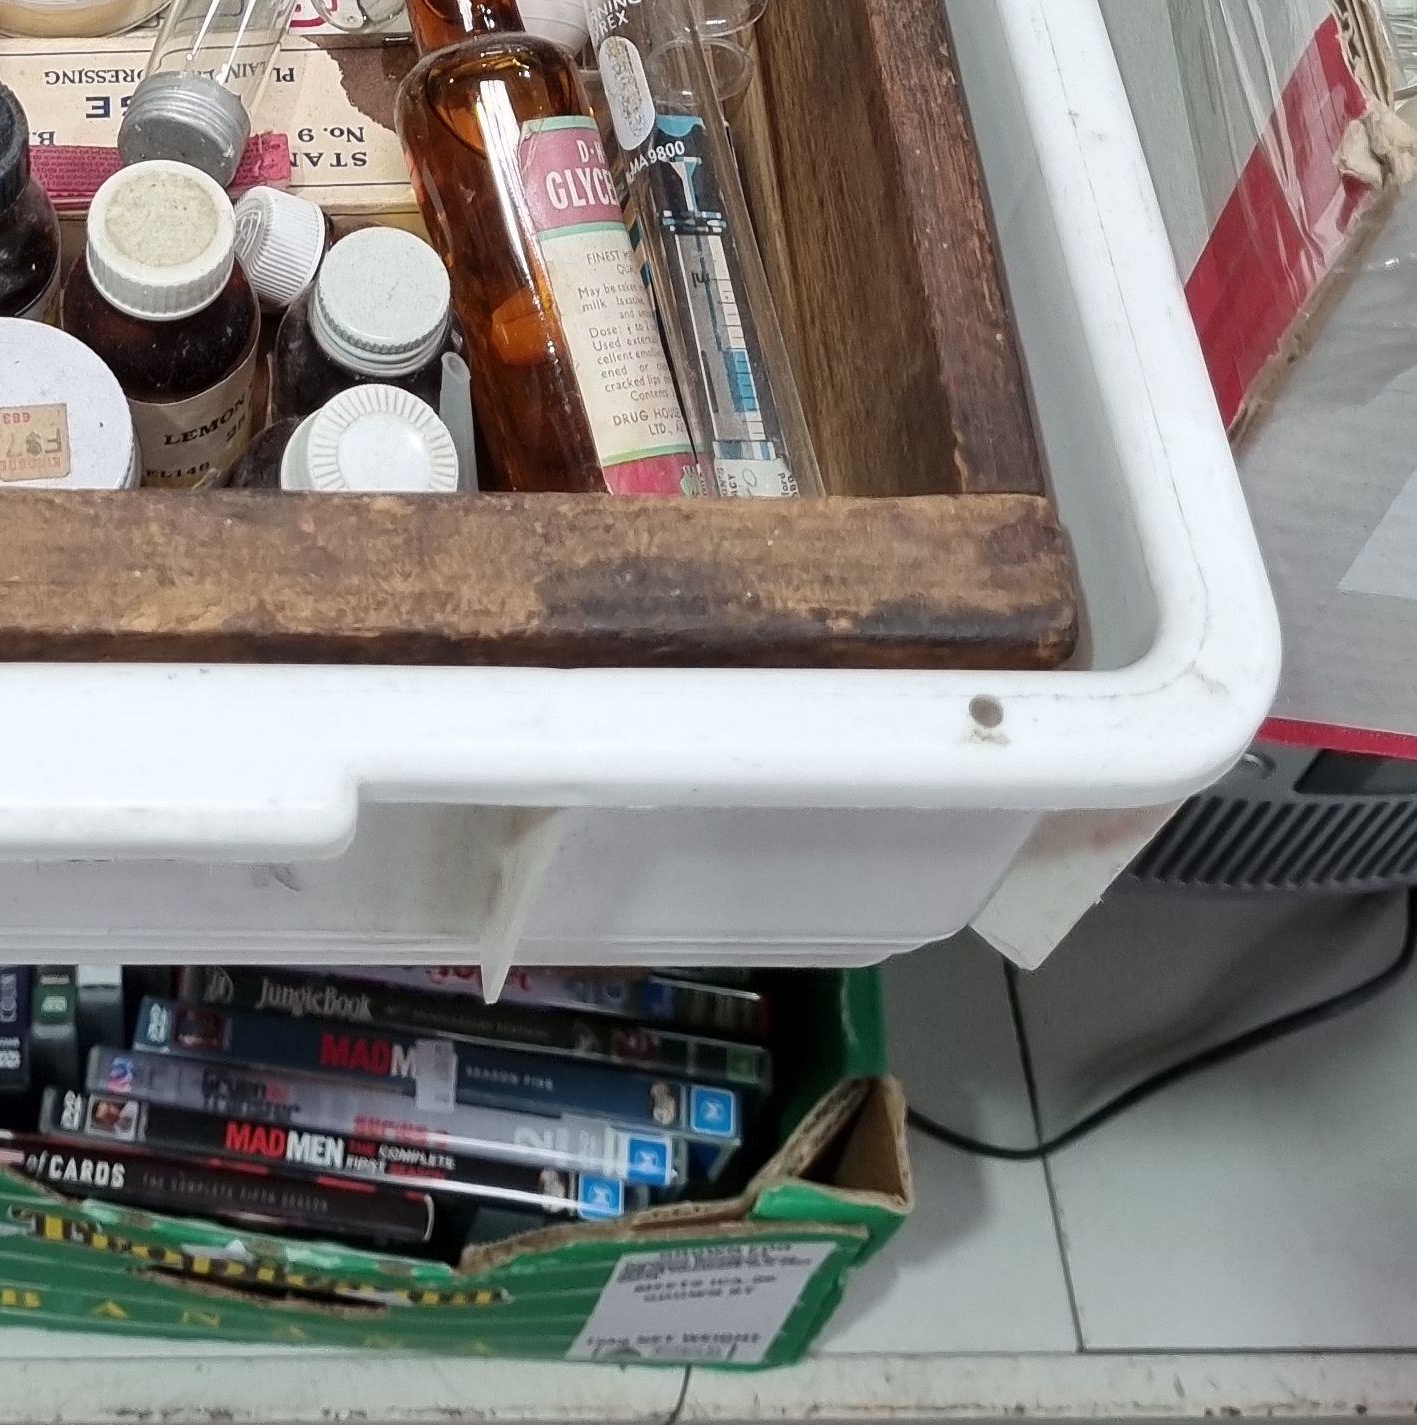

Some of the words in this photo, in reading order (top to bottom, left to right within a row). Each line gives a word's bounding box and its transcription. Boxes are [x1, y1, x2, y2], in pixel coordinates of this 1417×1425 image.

[298, 129, 314, 142] 9
[323, 127, 365, 142] No.
[648, 141, 685, 164] 9800
[545, 167, 620, 210] GLYCE
[577, 285, 601, 299] May
[603, 282, 616, 294] be
[583, 298, 607, 313] milk
[592, 336, 622, 352] Used
[597, 352, 634, 366] cellent
[600, 366, 628, 379] ened
[604, 377, 645, 393] cracked
[164, 392, 245, 446] LEMON
[612, 410, 650, 427] DRUG
[26, 1150, 48, 1176] of
[48, 1158, 126, 1190] CARDS
